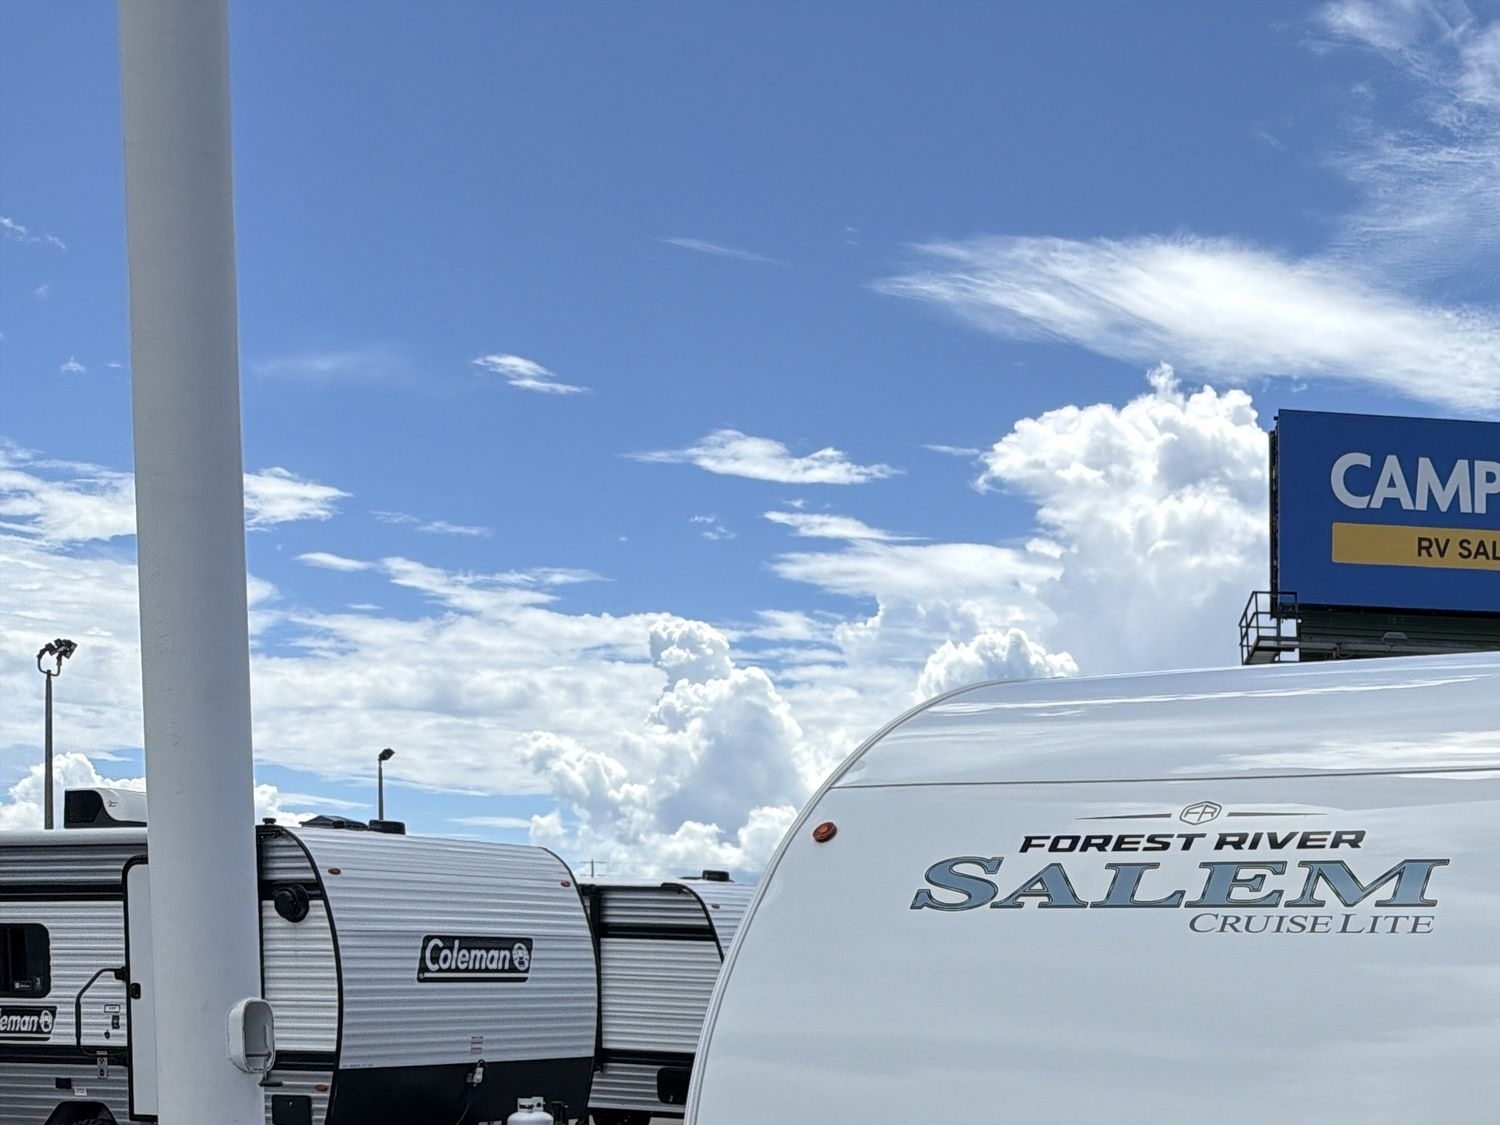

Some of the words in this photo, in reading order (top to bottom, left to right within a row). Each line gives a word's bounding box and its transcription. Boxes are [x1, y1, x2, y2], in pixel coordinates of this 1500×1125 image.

[1416, 537, 1450, 558] RV
[1019, 833, 1207, 853] FOREST
[1213, 830, 1366, 851] RIVER
[910, 856, 1450, 911] SALEM
[425, 939, 510, 971] Coleman
[0, 1010, 39, 1031] eman
